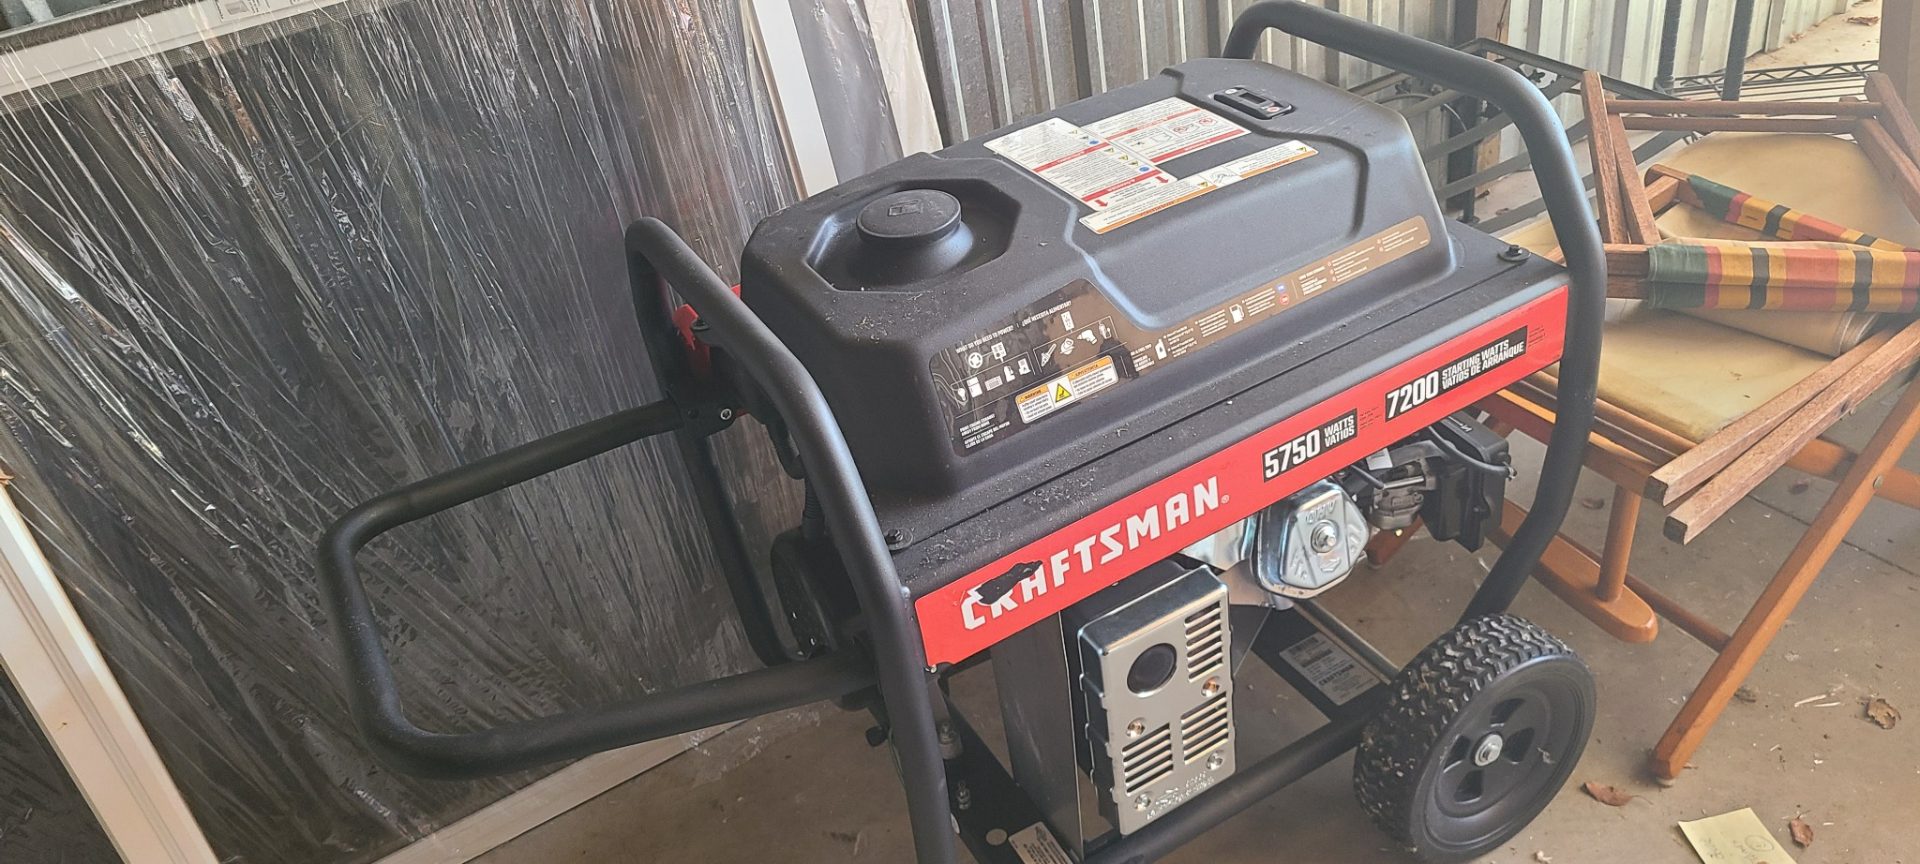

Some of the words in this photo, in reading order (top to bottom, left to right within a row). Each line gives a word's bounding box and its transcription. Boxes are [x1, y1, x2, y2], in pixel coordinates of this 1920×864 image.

[1442, 353, 1481, 379] STARTING
[1481, 339, 1509, 360] WATTS
[1442, 368, 1470, 390] VATIOS
[1470, 364, 1481, 376] DE
[1482, 341, 1524, 371] ARRANQUE
[1387, 370, 1439, 418] 7200
[1324, 414, 1354, 438] WATTS
[1325, 426, 1355, 448] VATIOS
[1264, 429, 1320, 478] 5750
